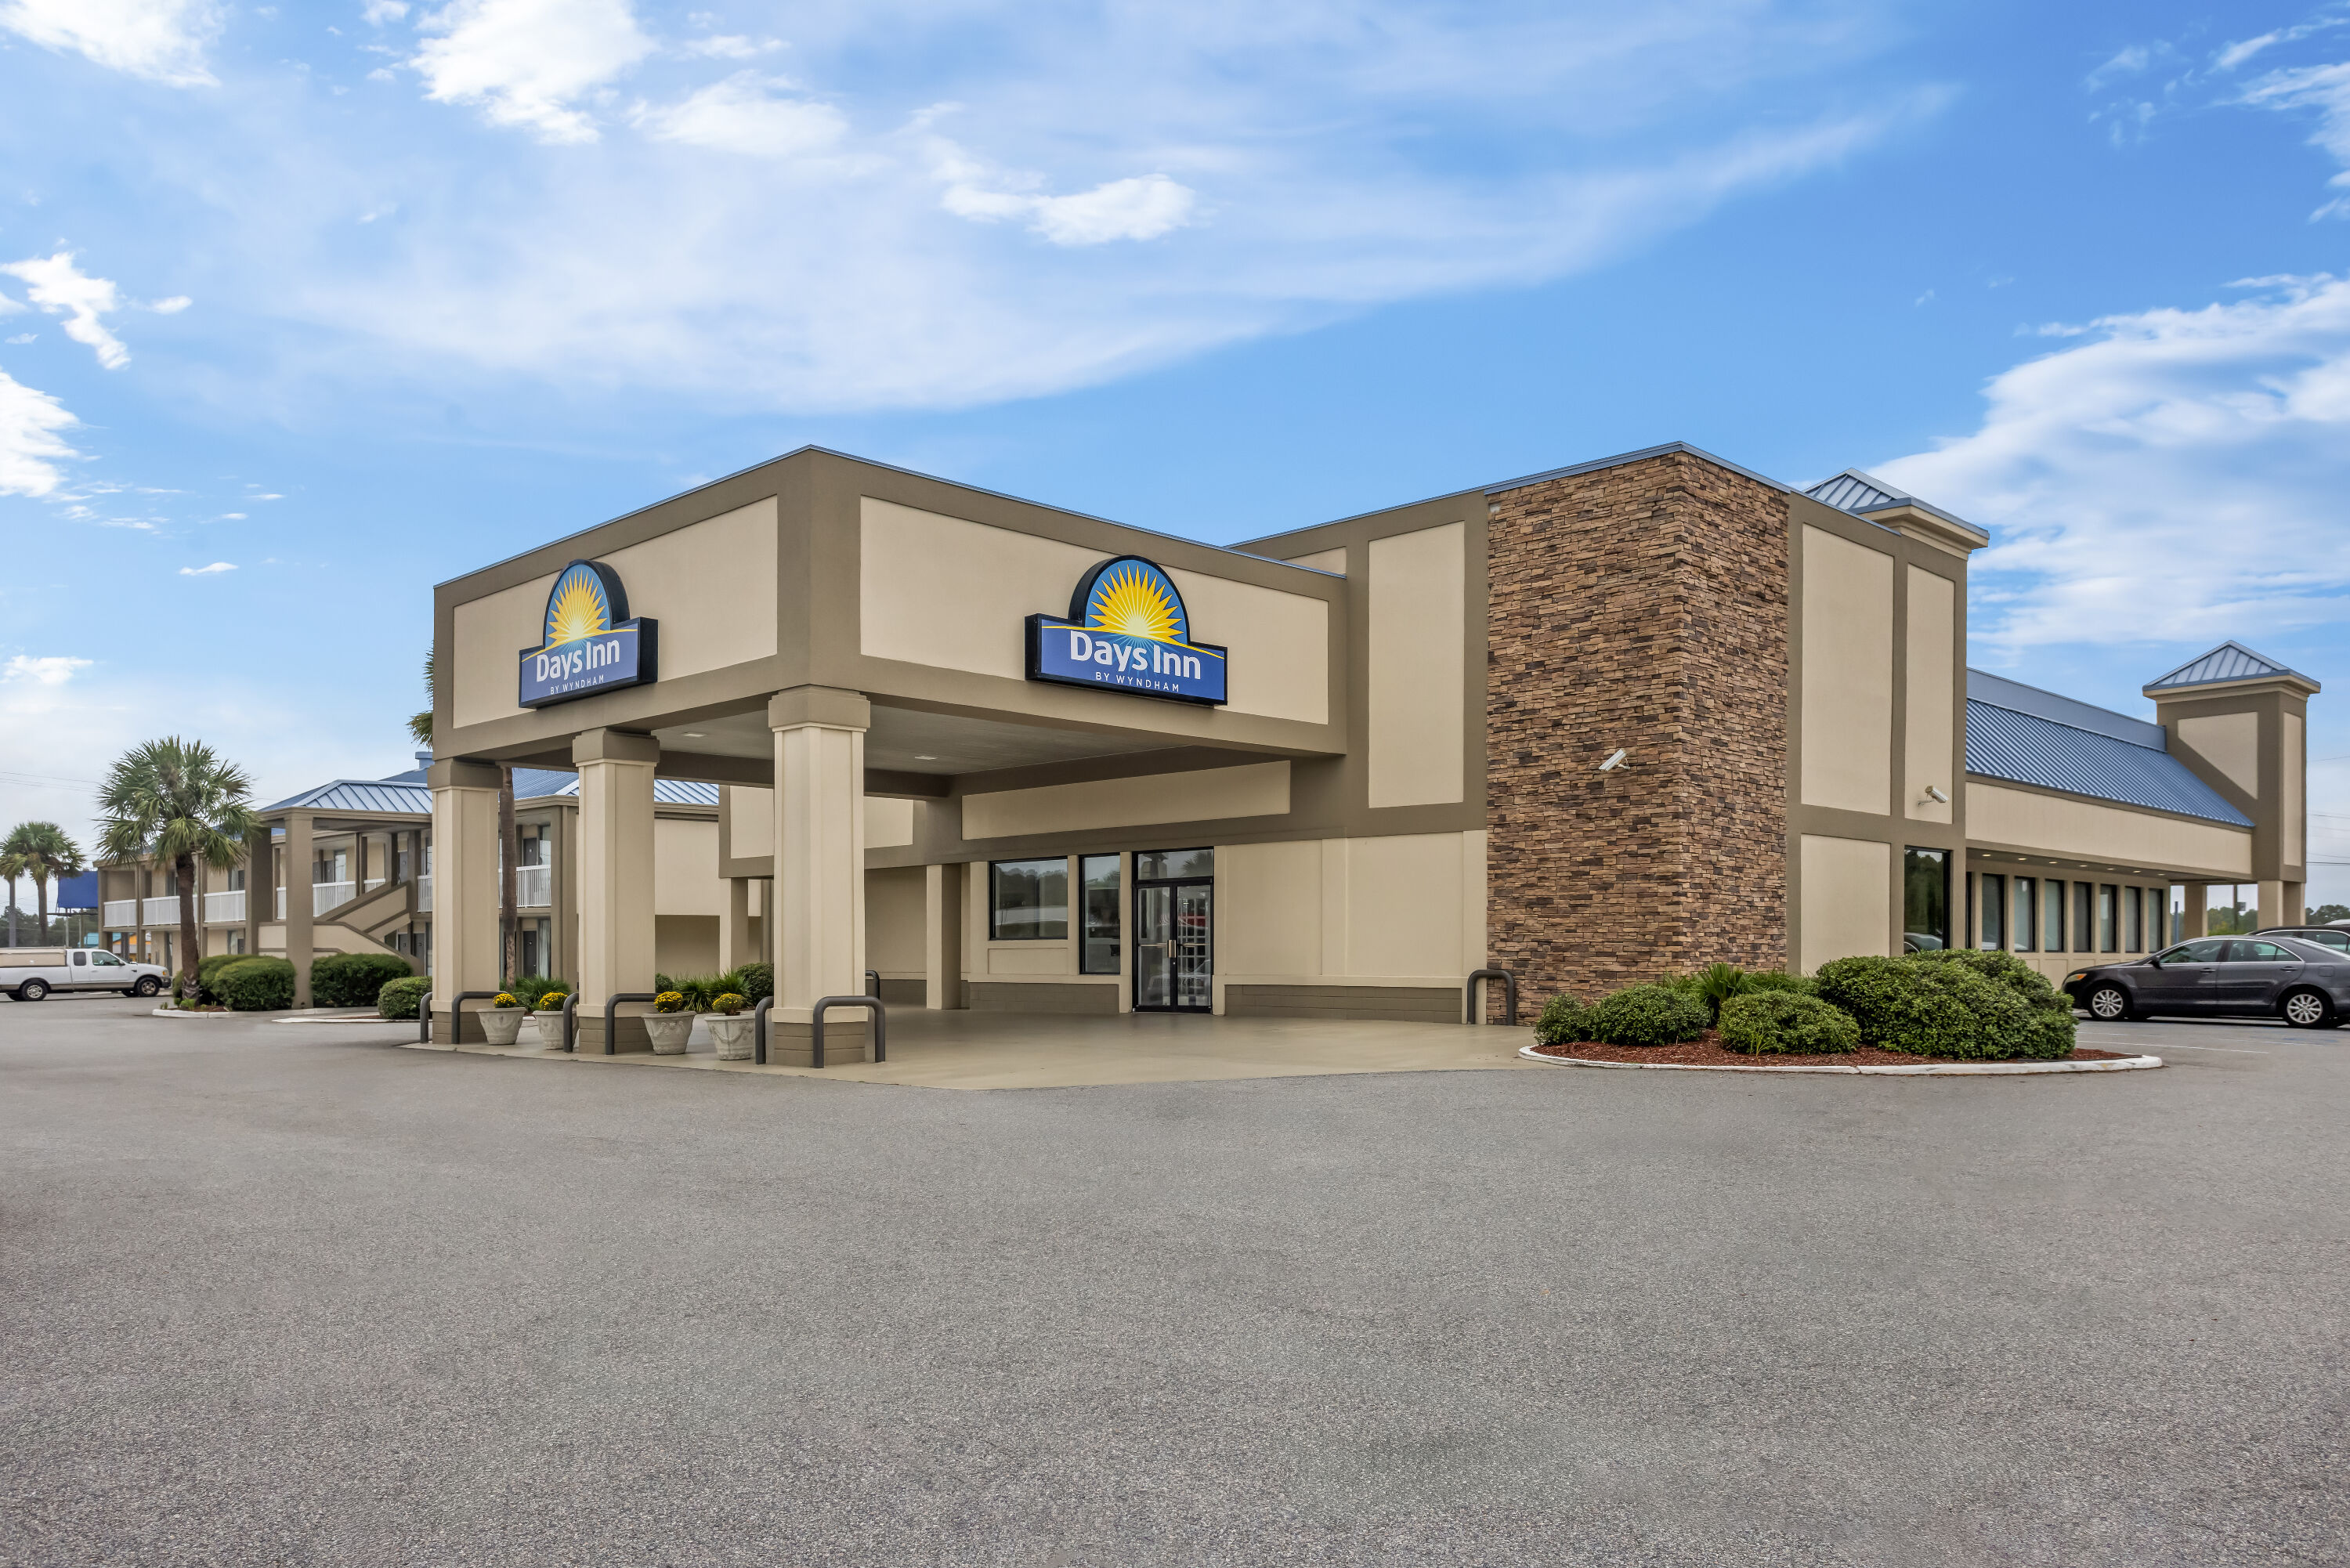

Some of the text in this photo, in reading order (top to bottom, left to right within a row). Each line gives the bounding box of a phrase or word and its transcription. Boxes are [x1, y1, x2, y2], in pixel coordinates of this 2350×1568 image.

[537, 640, 620, 682] Days Inn
[1070, 630, 1201, 679] Days Inn
[550, 674, 604, 695] BY WYNDHAM
[1096, 672, 1179, 692] BY WYNDHAM
